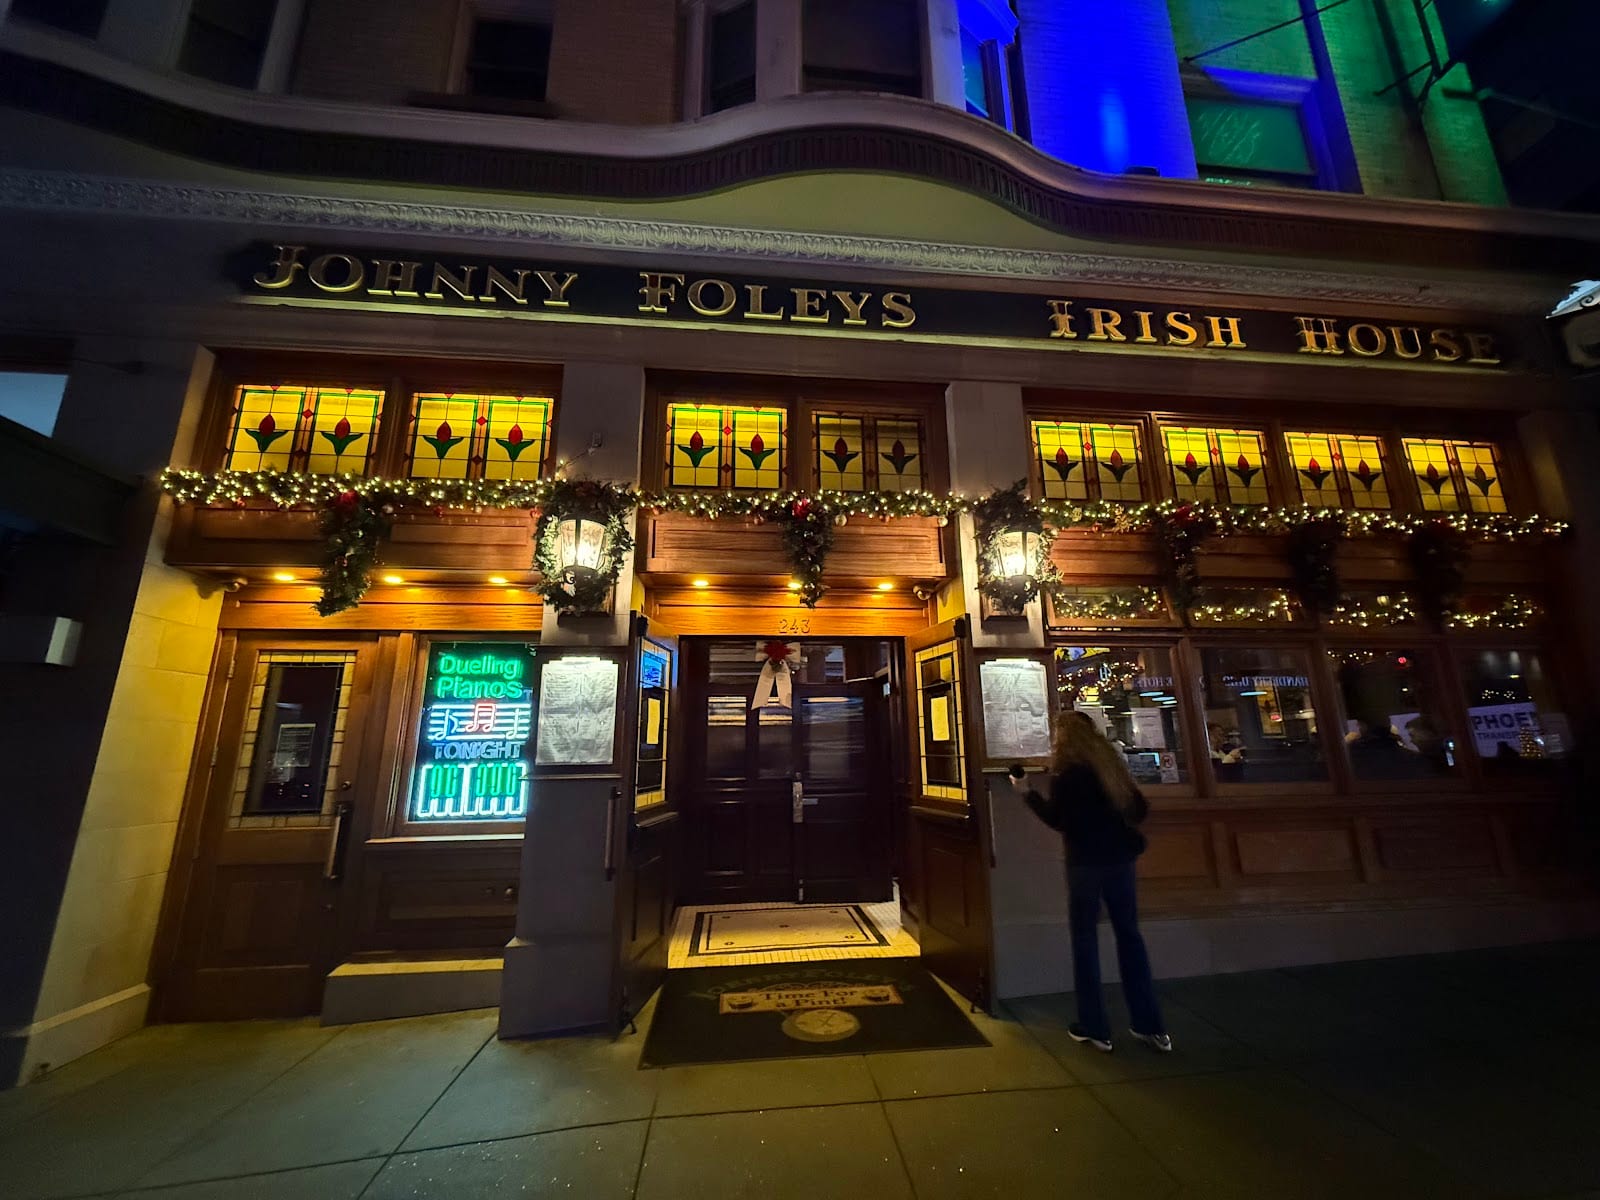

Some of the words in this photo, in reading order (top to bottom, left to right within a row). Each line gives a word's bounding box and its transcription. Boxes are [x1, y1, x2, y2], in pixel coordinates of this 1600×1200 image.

[252, 245, 578, 307] JOHNNY
[638, 271, 917, 328] FOLEYS
[1046, 300, 1247, 349] IRISH
[1295, 316, 1501, 365] HOUSE
[779, 618, 811, 634] 243
[439, 655, 520, 680] Dueling
[436, 676, 525, 699] Pianos
[432, 741, 524, 760] TONIGHT
[759, 991, 817, 1001] Time
